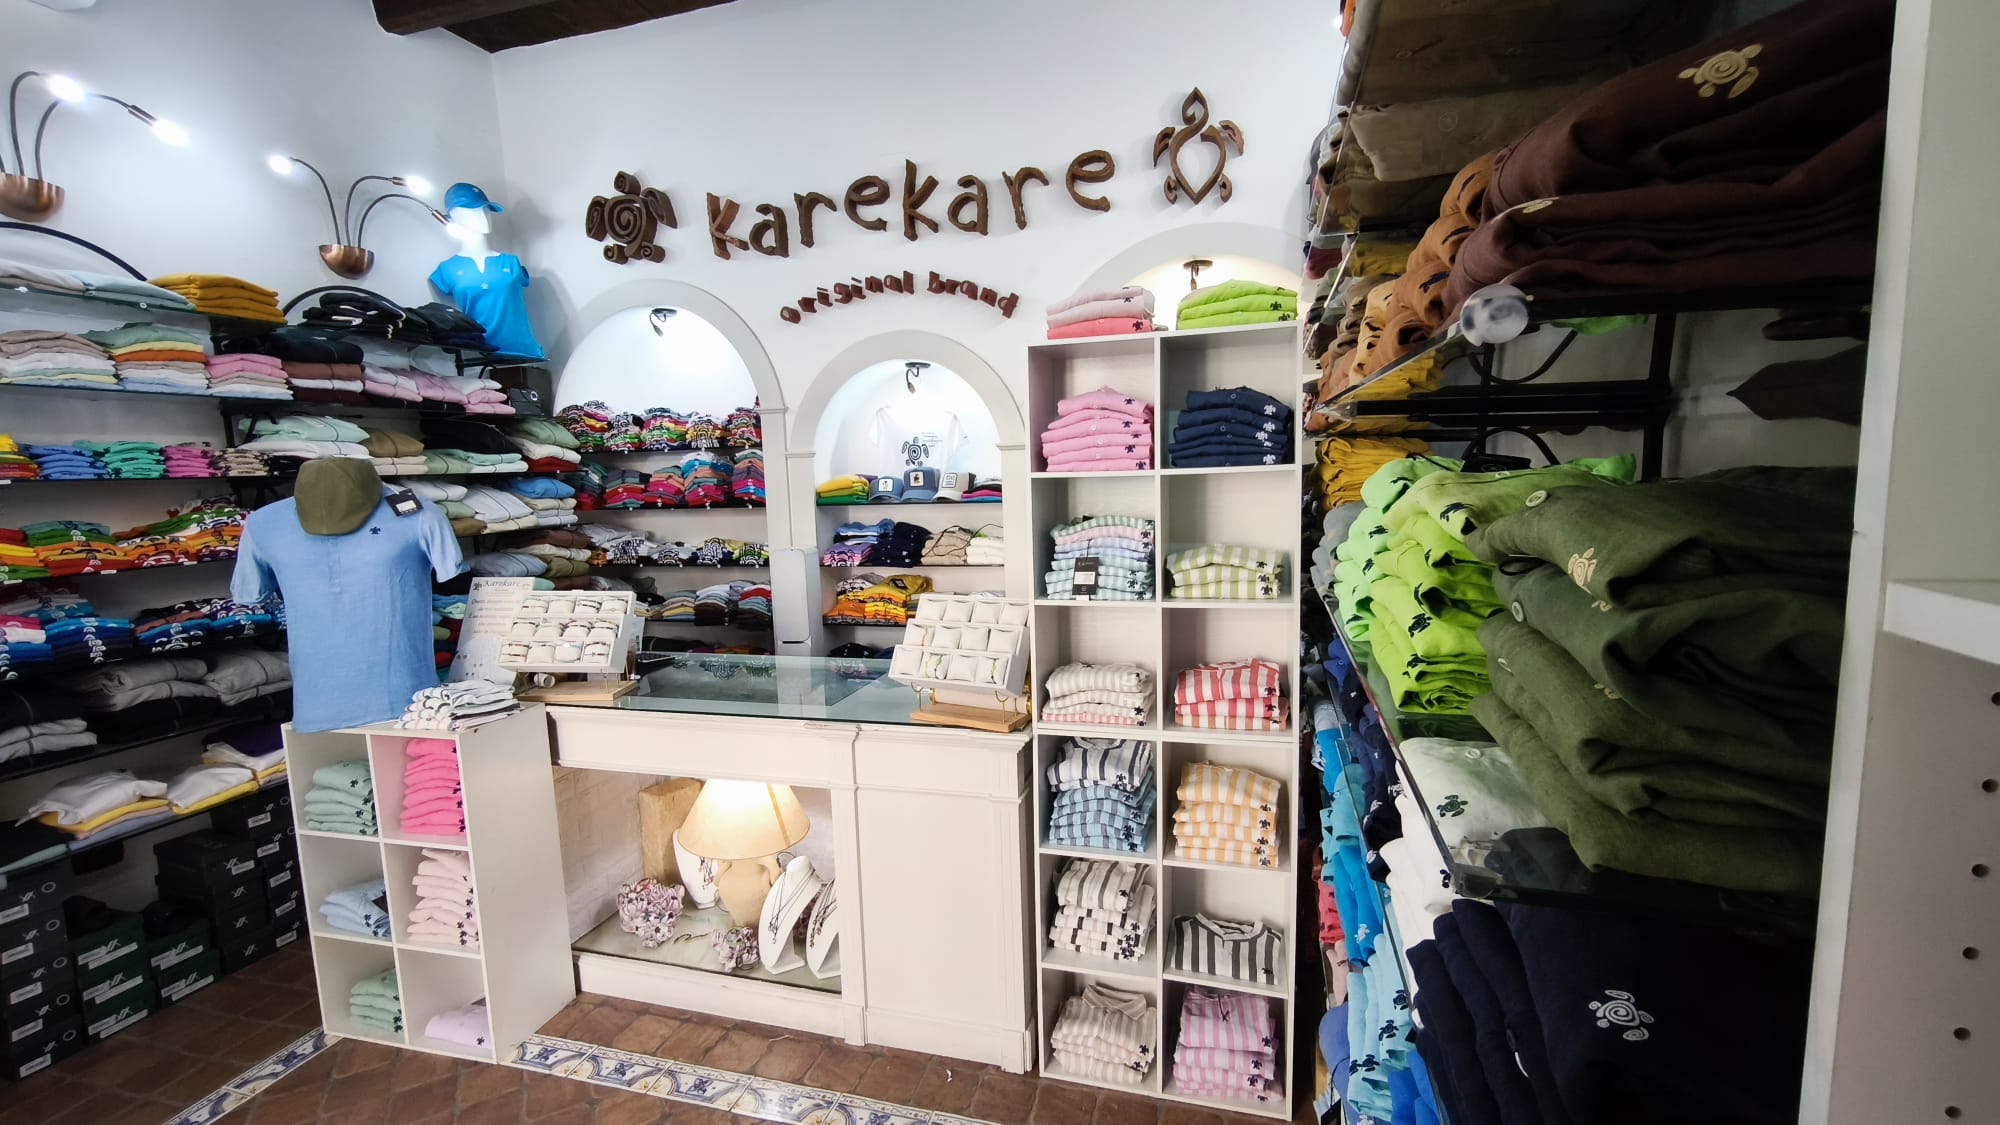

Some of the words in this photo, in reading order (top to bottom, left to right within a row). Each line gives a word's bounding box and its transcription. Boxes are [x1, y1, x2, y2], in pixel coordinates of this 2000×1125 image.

[706, 149, 1116, 260] karekare
[780, 270, 914, 324] original
[927, 270, 1020, 319] brand
